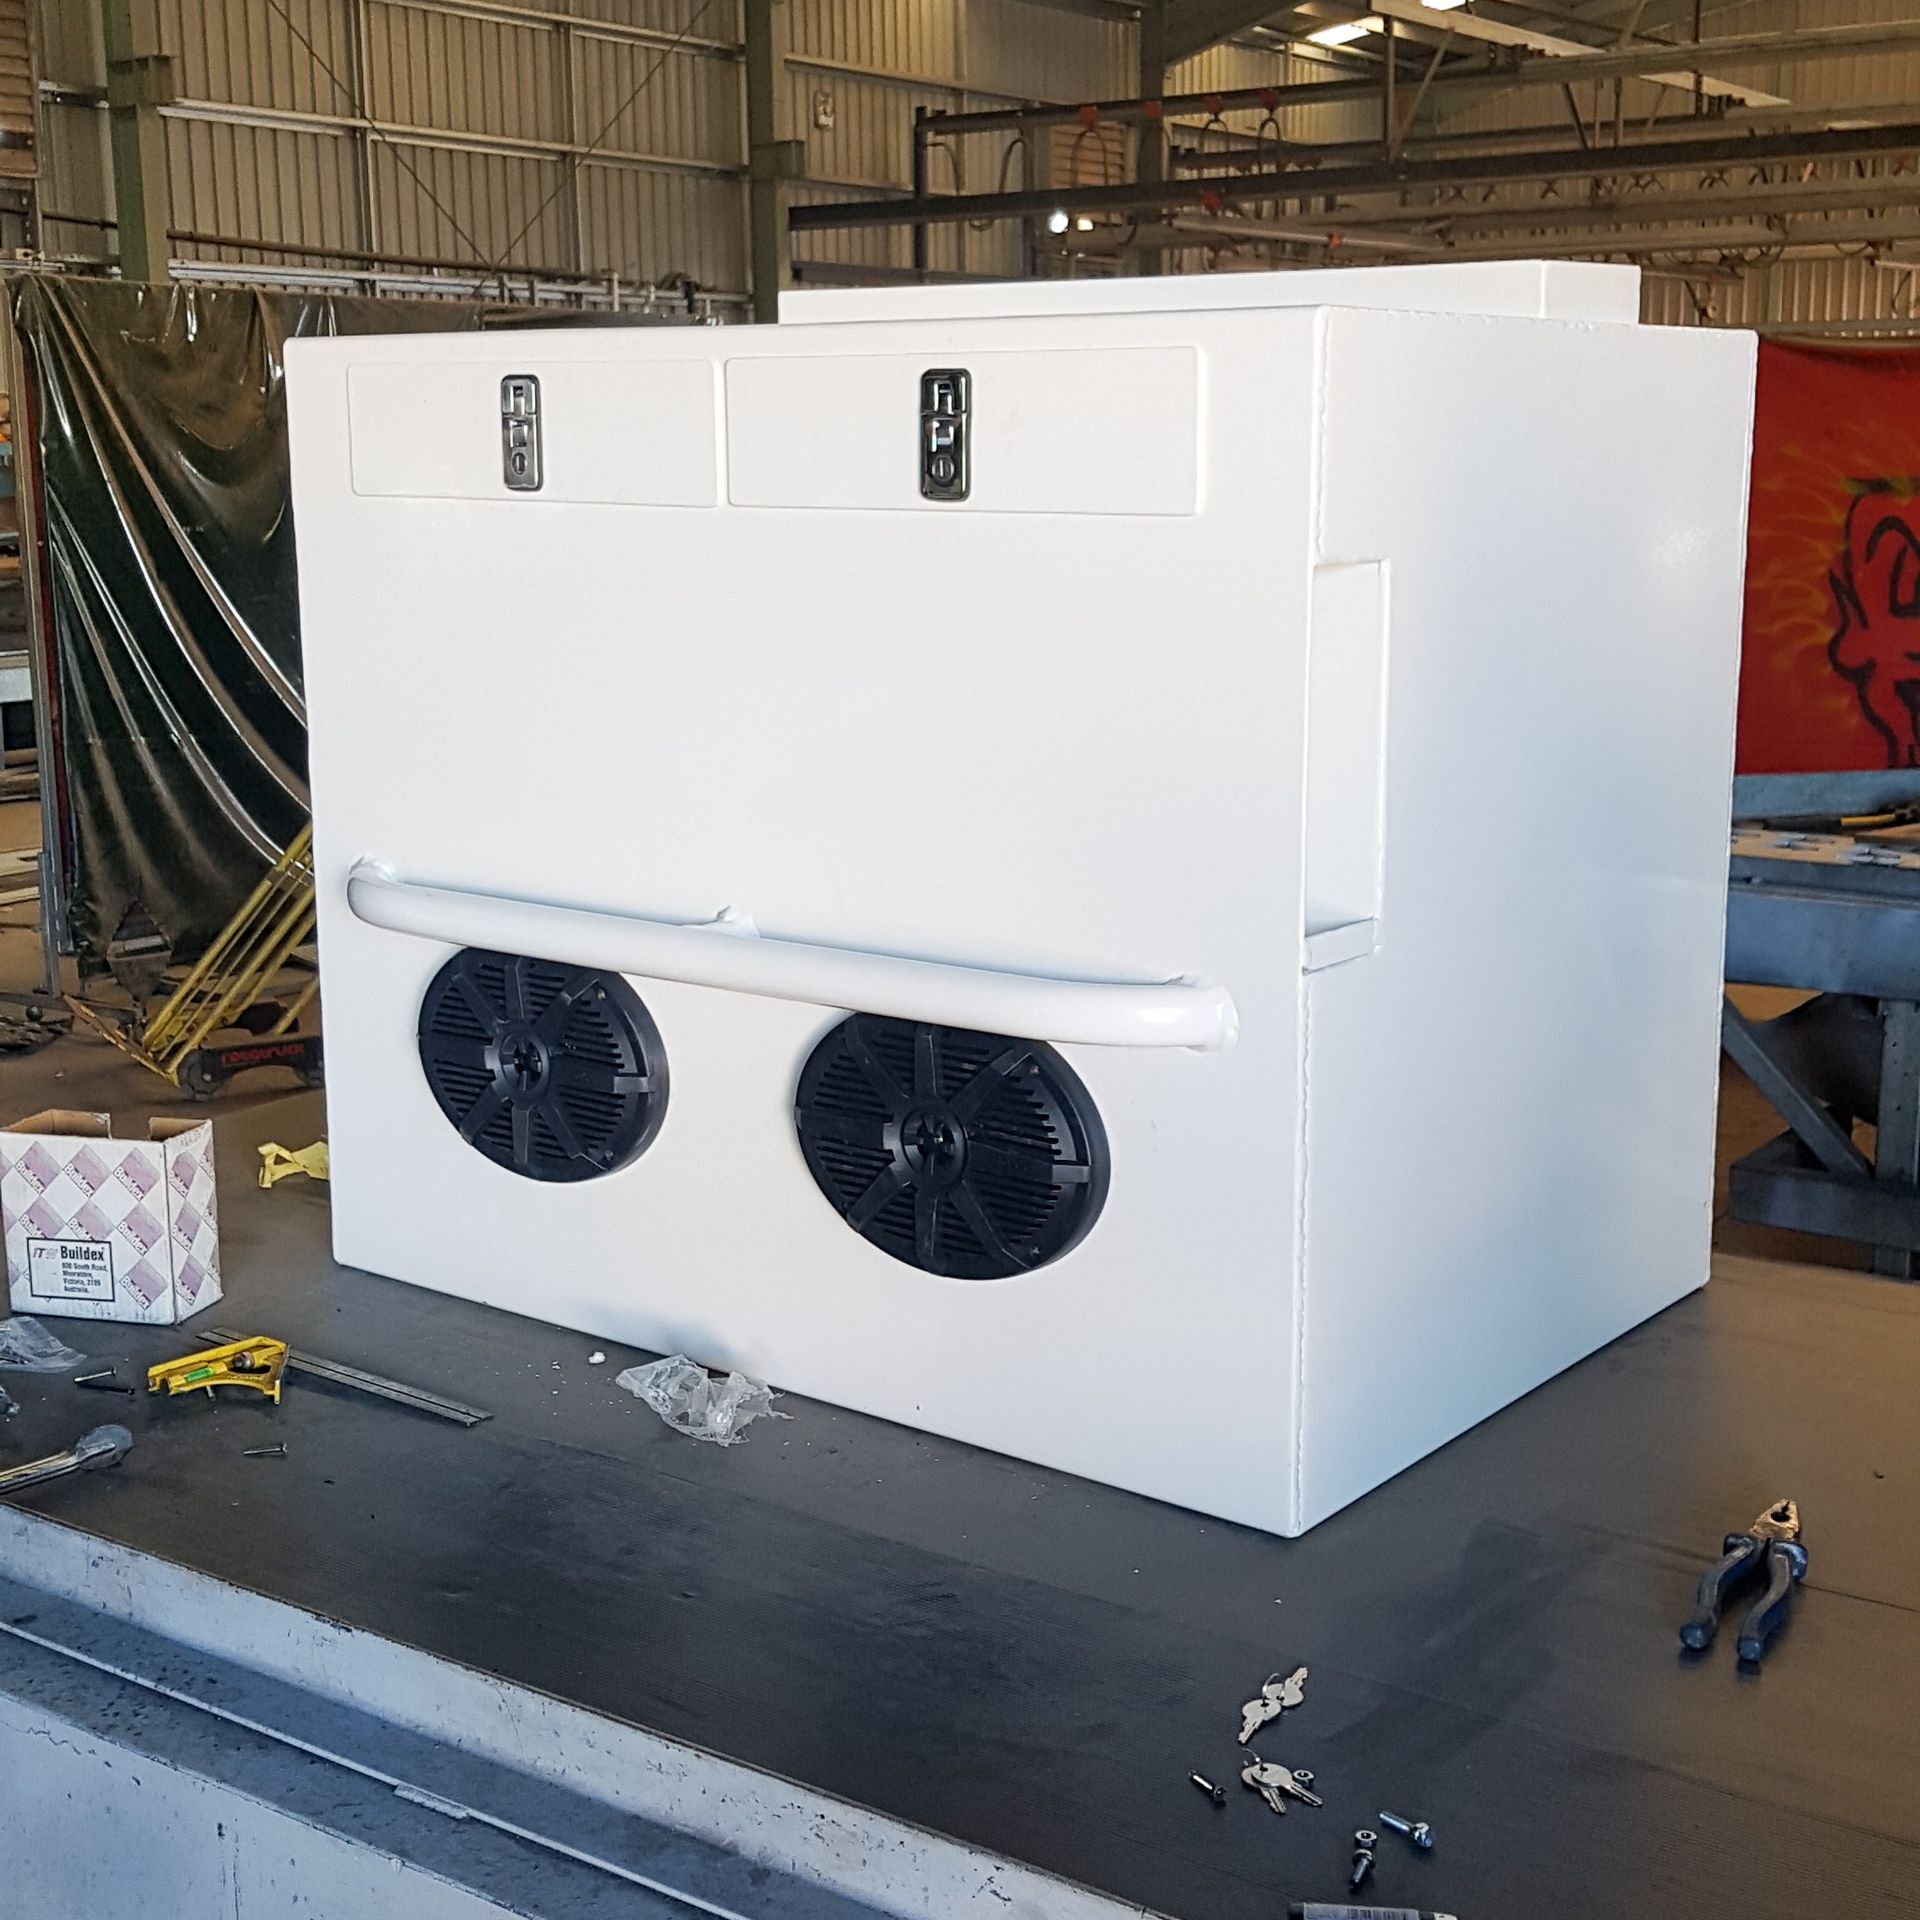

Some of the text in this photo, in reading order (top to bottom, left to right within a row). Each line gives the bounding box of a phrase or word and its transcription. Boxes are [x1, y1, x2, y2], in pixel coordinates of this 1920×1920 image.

[15, 1160, 46, 1195] Buildex
[64, 1163, 95, 1198] Buildex
[113, 1166, 145, 1202] Buildex
[61, 1246, 104, 1261] Buildex
[117, 1221, 149, 1257] Buildex
[120, 1276, 151, 1309] Buildex
